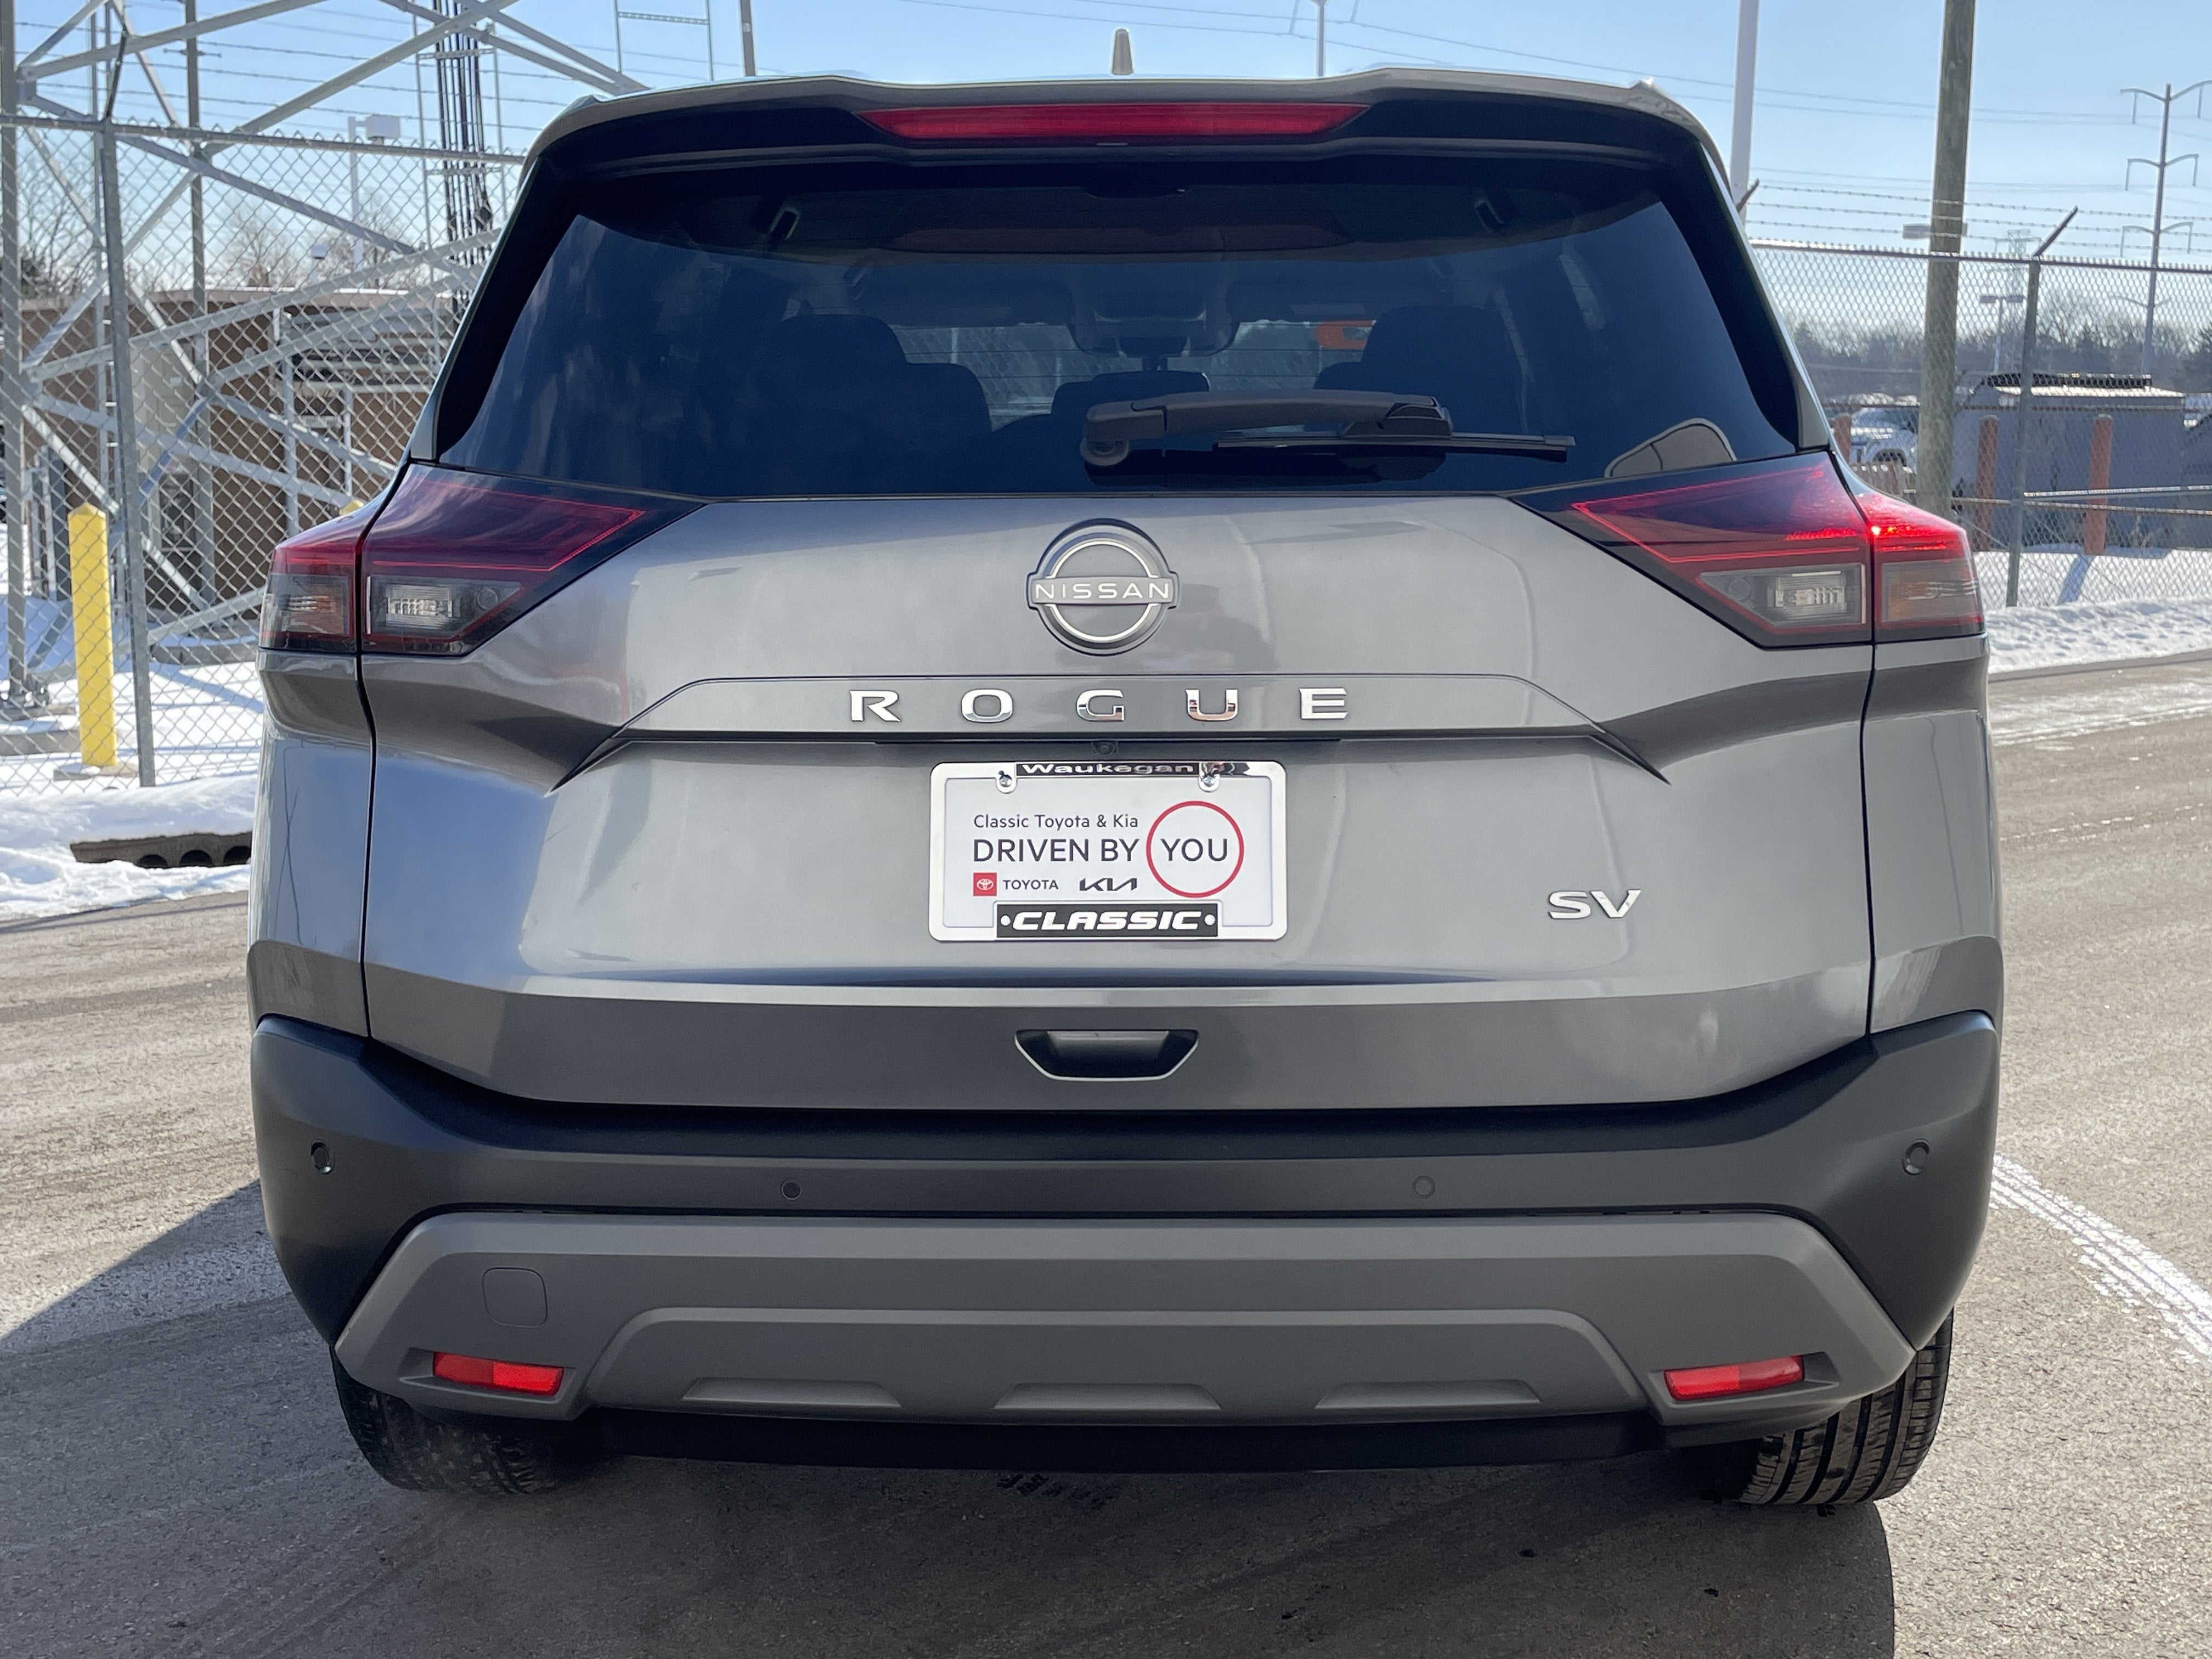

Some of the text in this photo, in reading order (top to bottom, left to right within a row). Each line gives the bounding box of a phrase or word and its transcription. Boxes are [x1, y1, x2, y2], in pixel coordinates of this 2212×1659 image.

[1035, 583, 1169, 600] NISSAN
[850, 687, 1348, 723] ROGUE
[1022, 763, 1194, 775] Waukegan
[973, 814, 1138, 831] Classic Toyota & Kia
[973, 838, 1228, 862] DRIVEN BY YOU
[1003, 880, 1059, 890] TOYOTA
[1548, 889, 1642, 919] SV
[1013, 912, 1202, 930] CLASSIC
